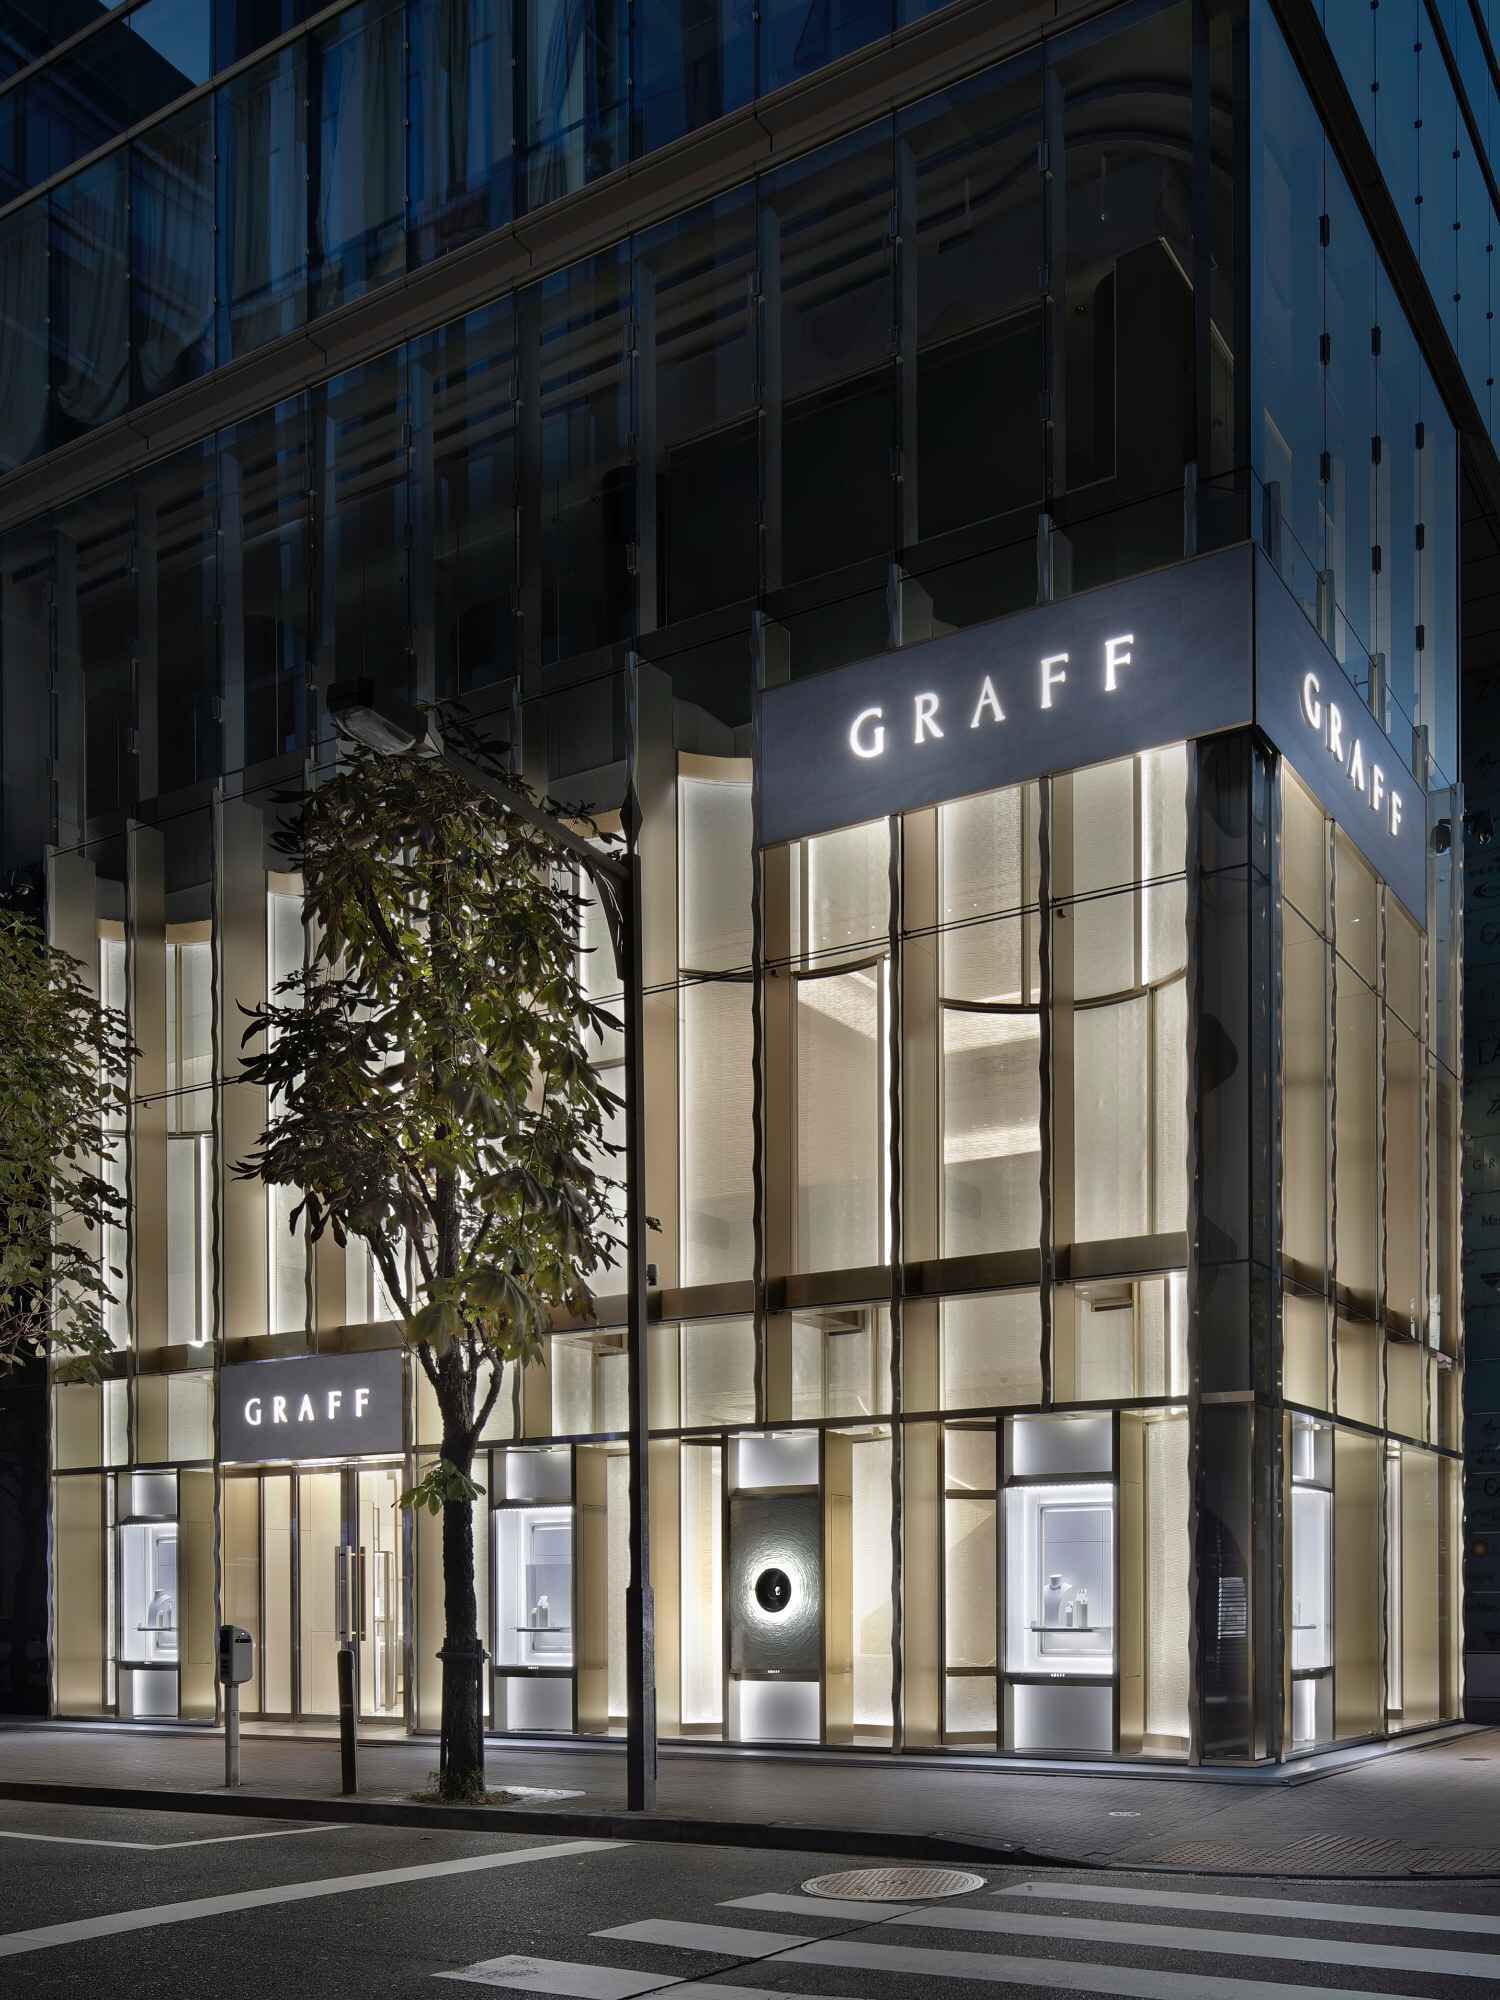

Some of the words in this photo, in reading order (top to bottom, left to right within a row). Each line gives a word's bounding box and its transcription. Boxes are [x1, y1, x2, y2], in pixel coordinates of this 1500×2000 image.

[848, 633, 1135, 760] GRAFF
[1302, 671, 1403, 837] GRAFF
[243, 1387, 371, 1427] GRAFF
